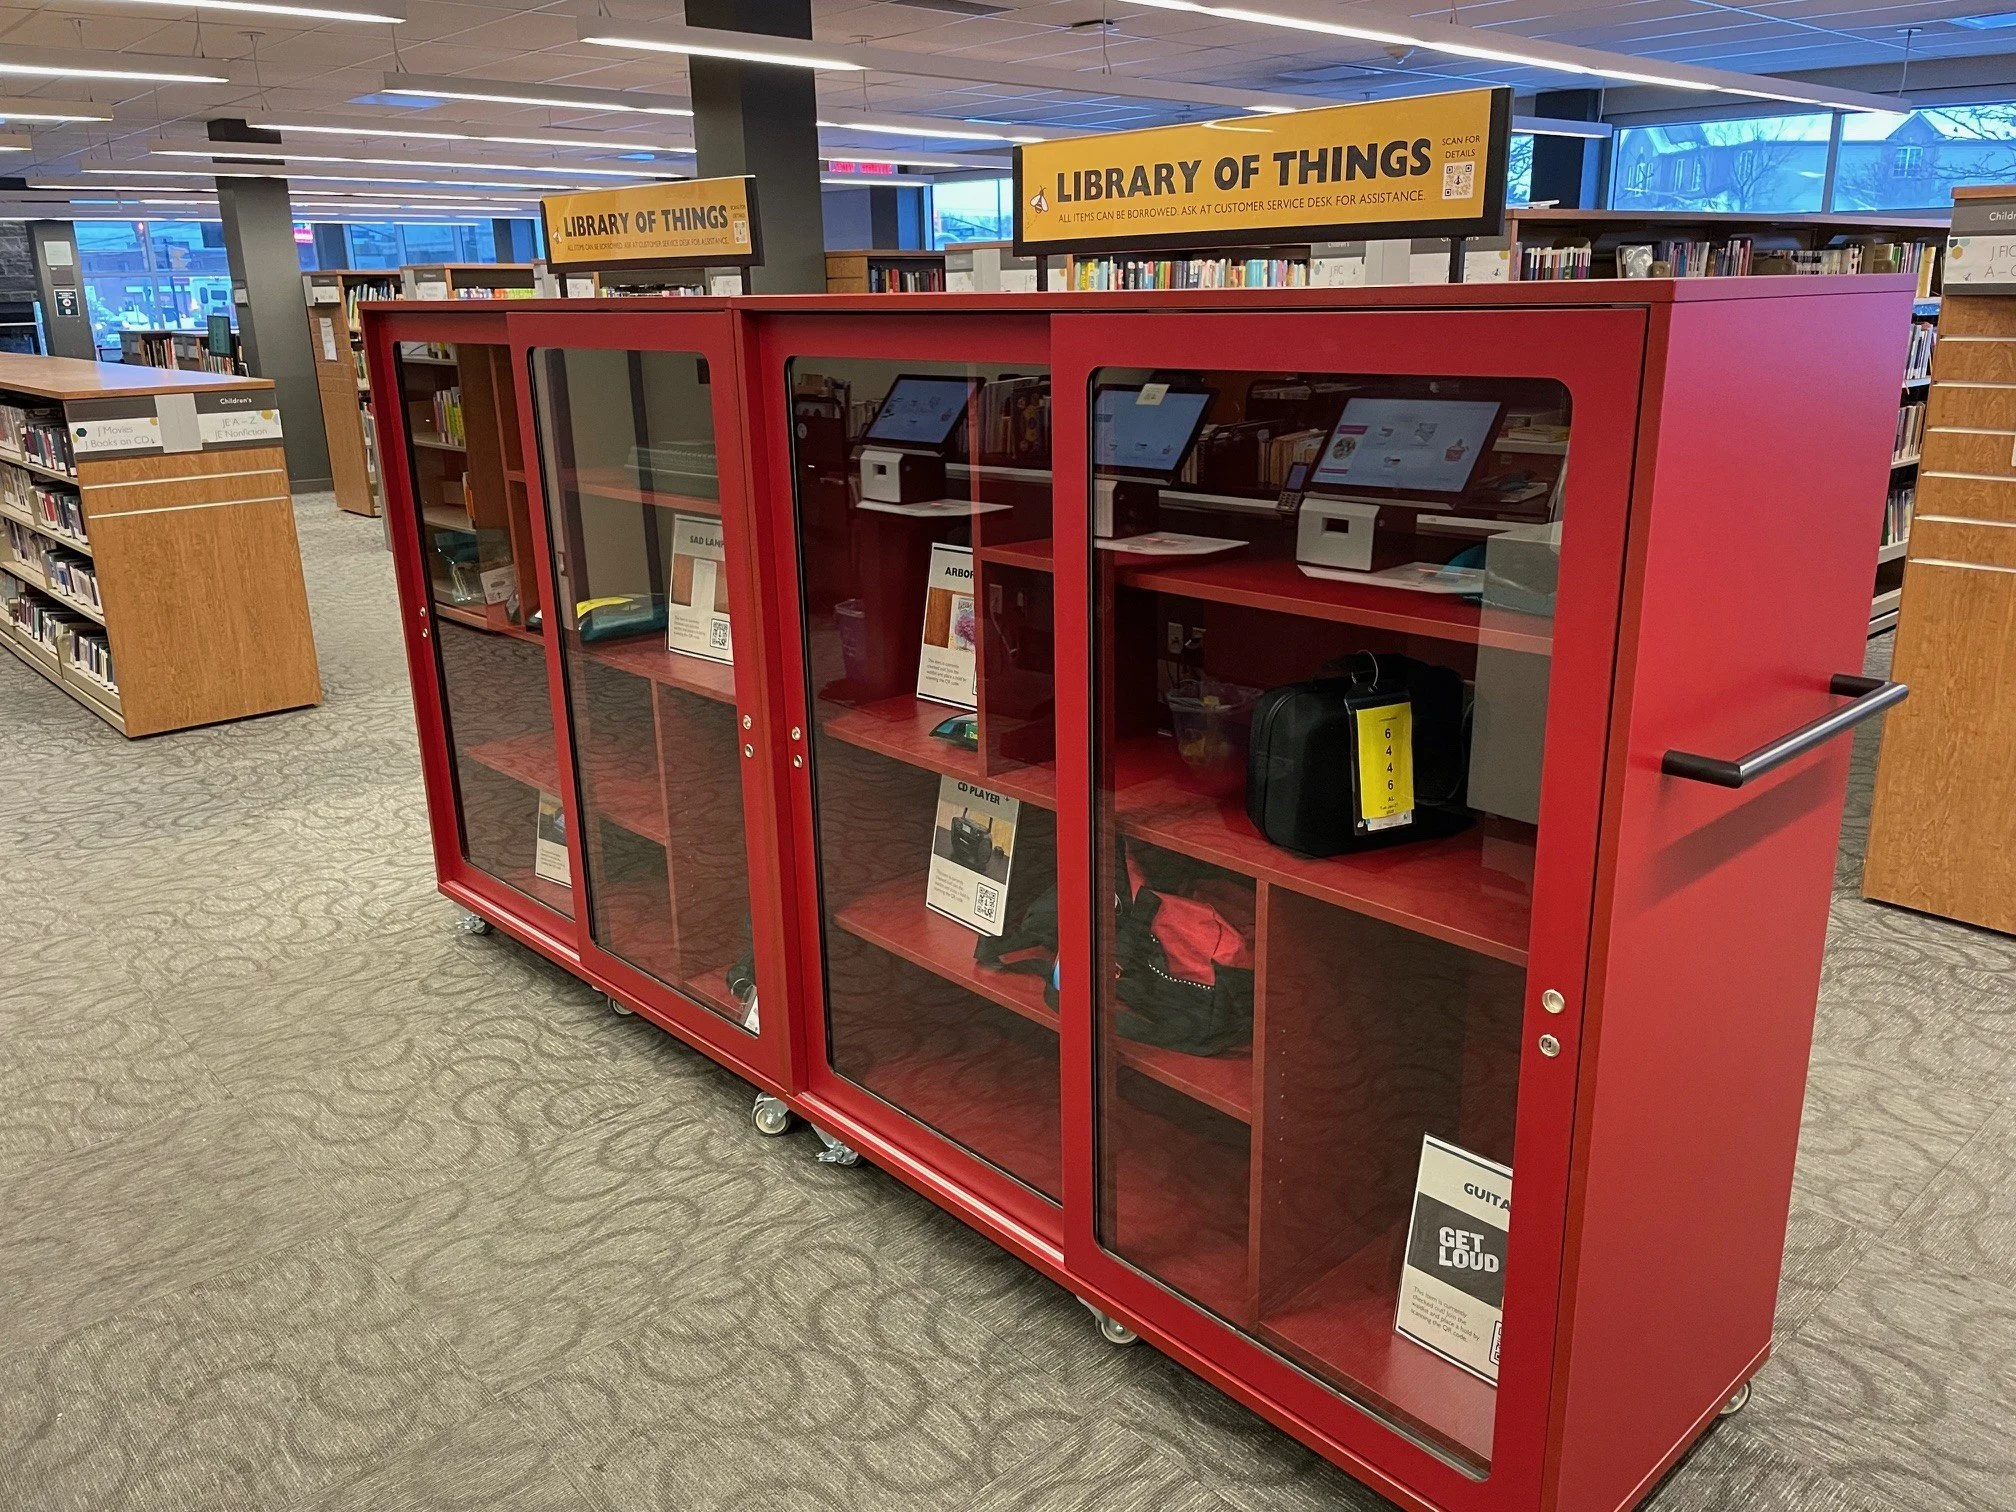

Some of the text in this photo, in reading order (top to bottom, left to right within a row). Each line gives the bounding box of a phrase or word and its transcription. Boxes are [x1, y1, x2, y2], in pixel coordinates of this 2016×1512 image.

[1442, 135, 1480, 146] SCAN FOR
[1445, 149, 1476, 159] DETAILS
[1057, 138, 1431, 203] LIBRARY OF THINGS
[1058, 189, 1426, 223] ALL ITEMS CAN BE BORROWED. ASK AT CUSTOMER SERVICE DESK FOR ASSISTANCE.
[563, 204, 728, 237] LIBRARY OF THINGS
[1985, 266, 1995, 278] A
[220, 397, 252, 405] Children's
[233, 418, 240, 427] A
[250, 416, 258, 425] Z
[103, 425, 133, 435] Movies
[225, 428, 268, 439] Nonfiction
[90, 437, 118, 448] Books
[120, 437, 132, 446] on
[134, 436, 150, 445] CD
[690, 535, 704, 545] SAD
[957, 781, 1001, 806] CD PLAYER
[1438, 1226, 1485, 1253] GET
[1438, 1245, 1500, 1273] LOUD
[1413, 1286, 1424, 1296] This
[1443, 1302, 1467, 1319] currently
[1410, 1308, 1431, 1325] scanning
[1442, 1324, 1452, 1333] QR
[1430, 1311, 1440, 1320] and
